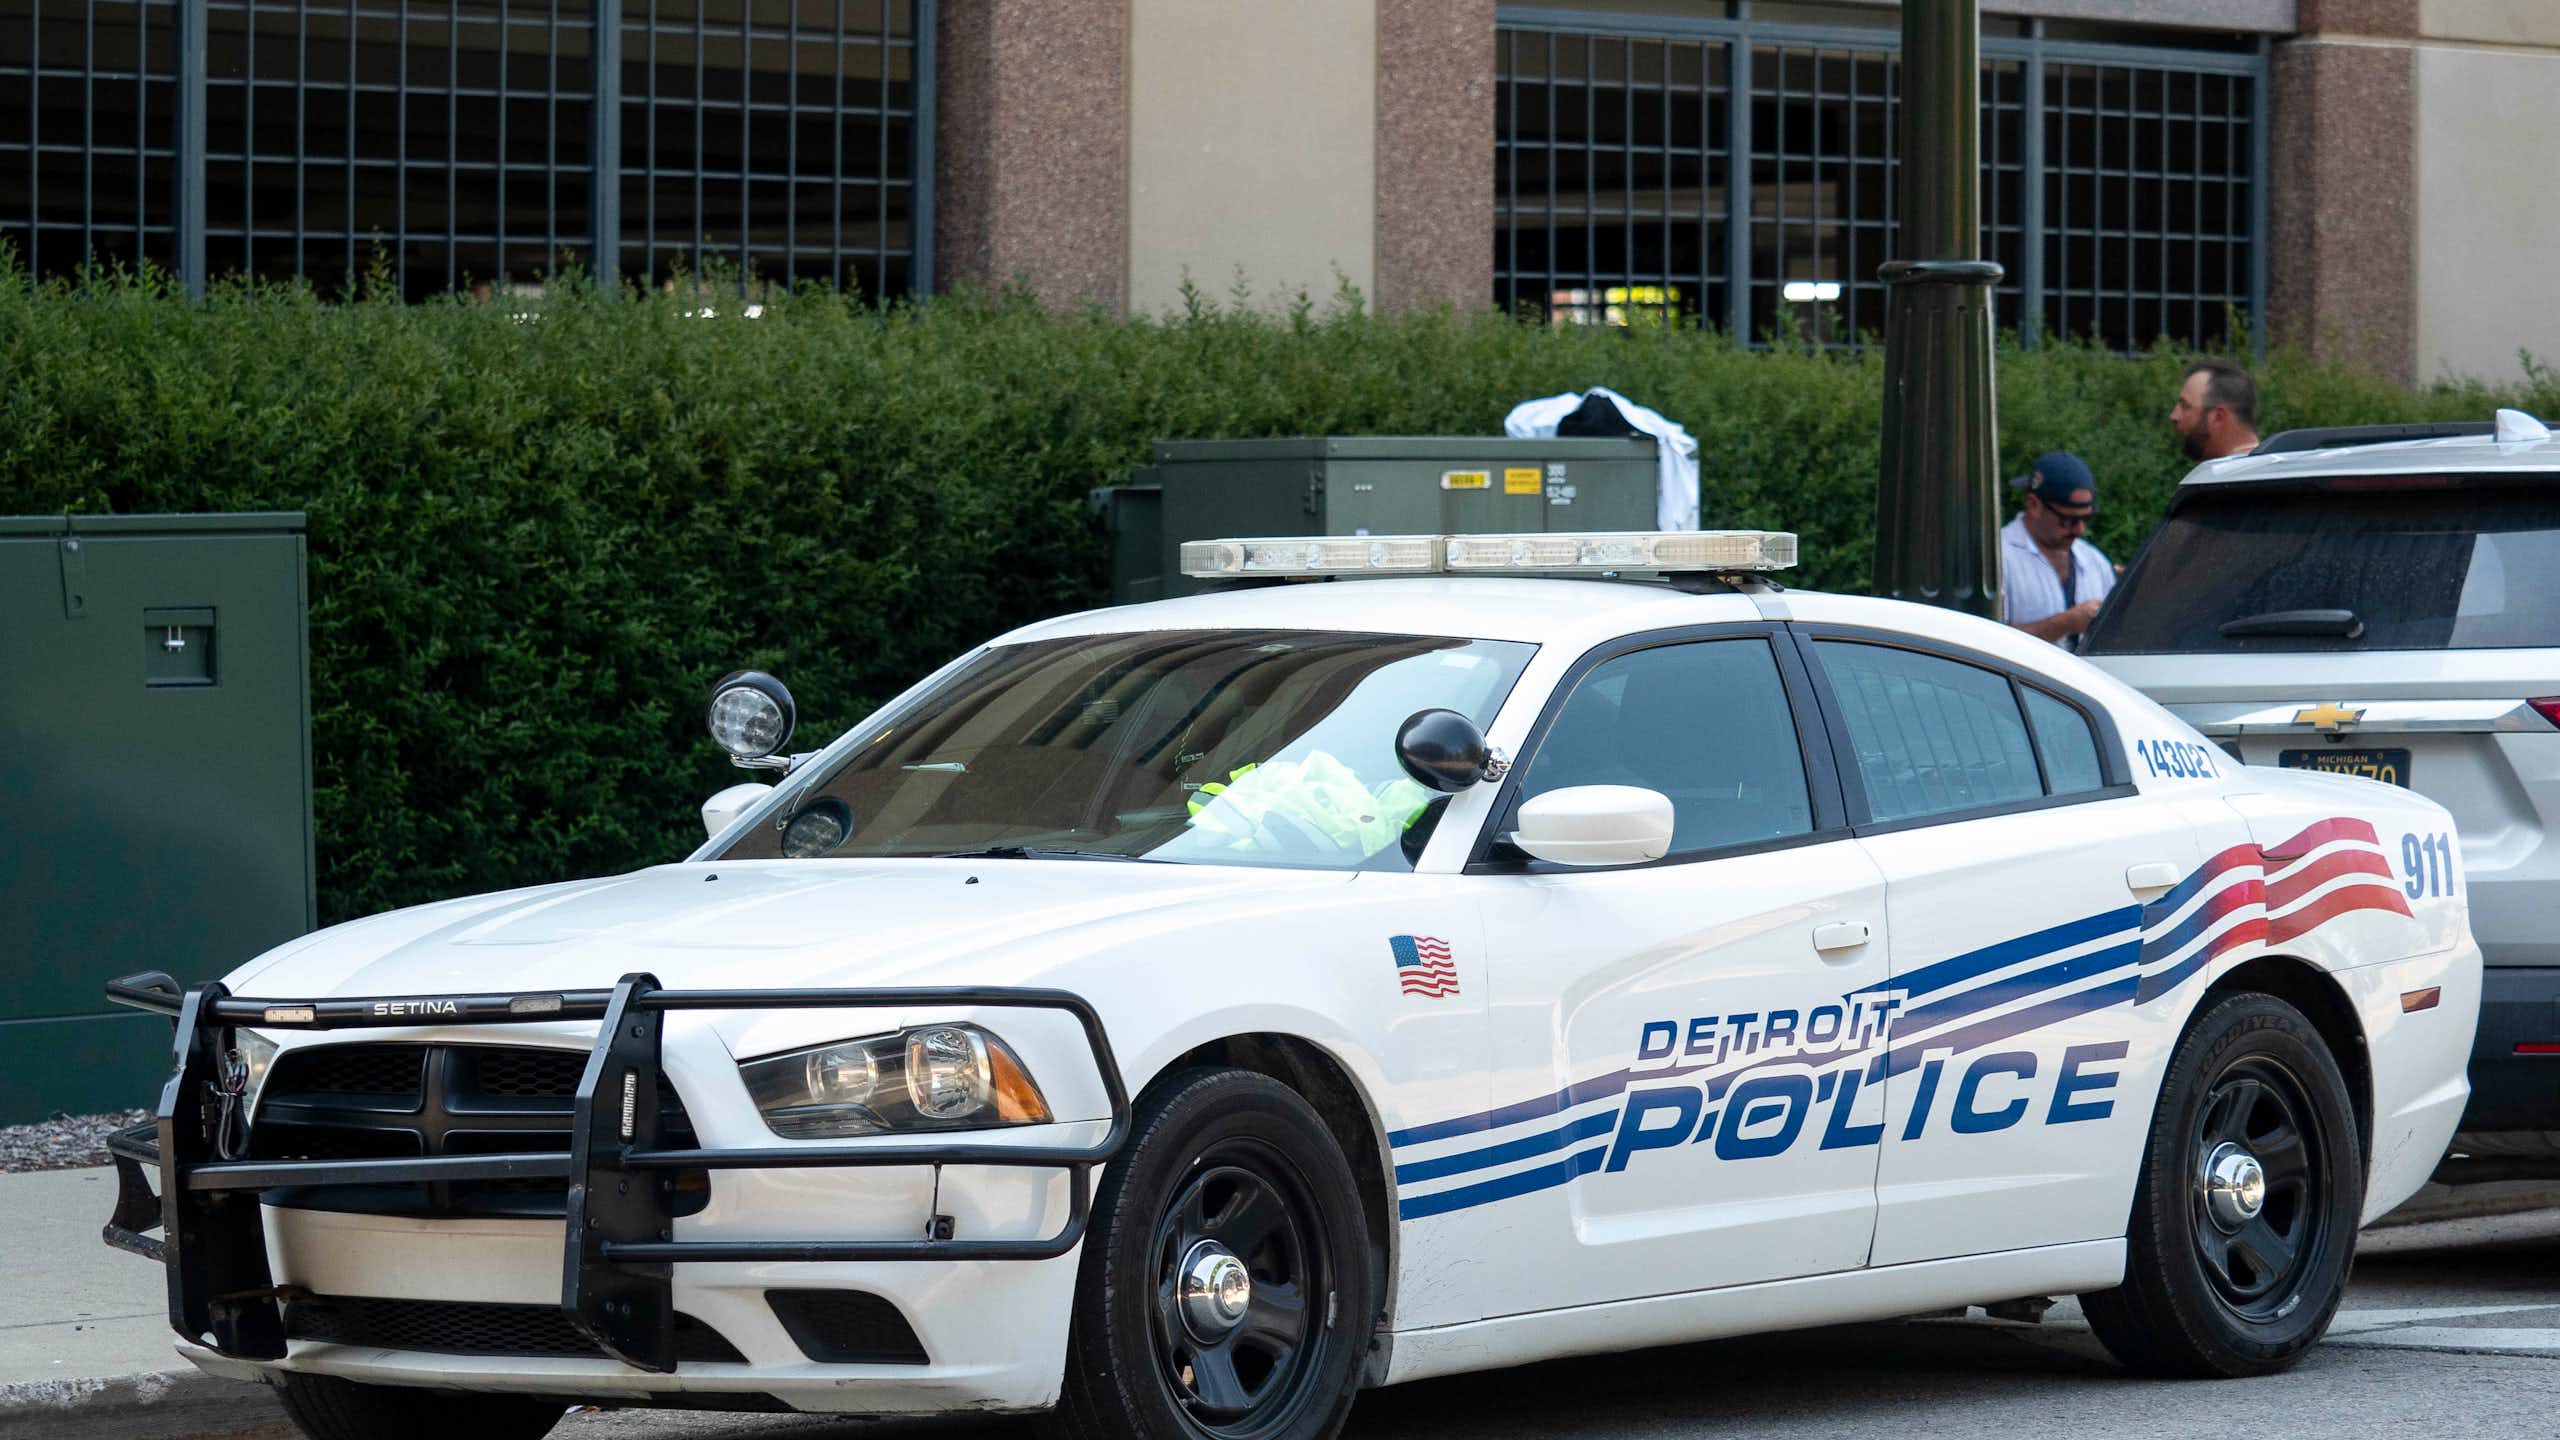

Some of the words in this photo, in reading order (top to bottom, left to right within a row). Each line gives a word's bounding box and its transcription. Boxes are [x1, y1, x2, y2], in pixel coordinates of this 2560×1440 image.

[2138, 739, 2221, 778] 143027
[2317, 755, 2369, 763] MICHIGAN
[2402, 832, 2454, 900] 911
[374, 1001, 457, 1015] SETINA
[1637, 998, 1902, 1061] DETROIT
[1604, 1040, 2130, 1174] POLICE
